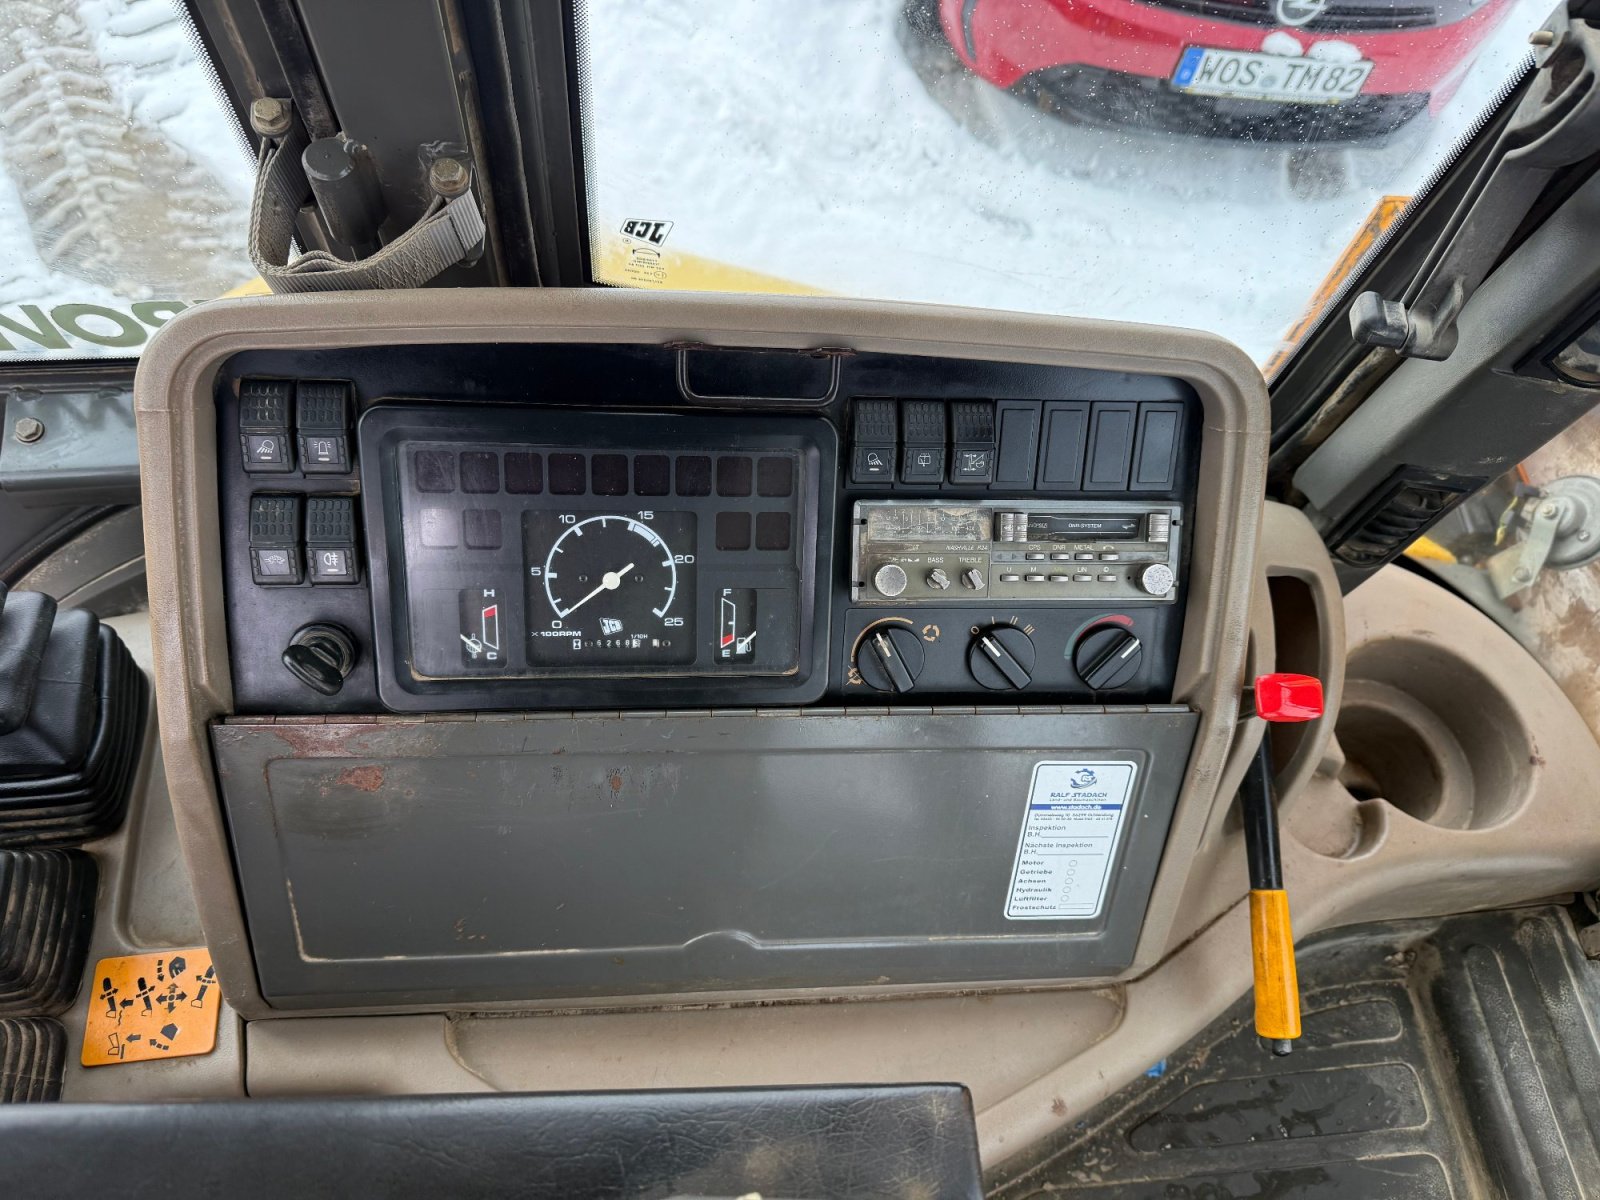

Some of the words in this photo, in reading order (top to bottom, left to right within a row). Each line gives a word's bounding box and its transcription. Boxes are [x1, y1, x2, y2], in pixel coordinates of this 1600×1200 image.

[1200, 55, 1263, 86] WOS
[1281, 62, 1365, 93] TM82
[558, 514, 576, 524] 10
[638, 511, 654, 520] 15
[674, 554, 695, 564] 20
[531, 567, 542, 576] 5
[483, 589, 495, 597] H
[723, 588, 732, 597] F
[551, 620, 562, 629] 0
[664, 617, 684, 627] 25
[602, 619, 623, 635] JCB
[486, 651, 498, 660] C
[722, 650, 731, 658] E
